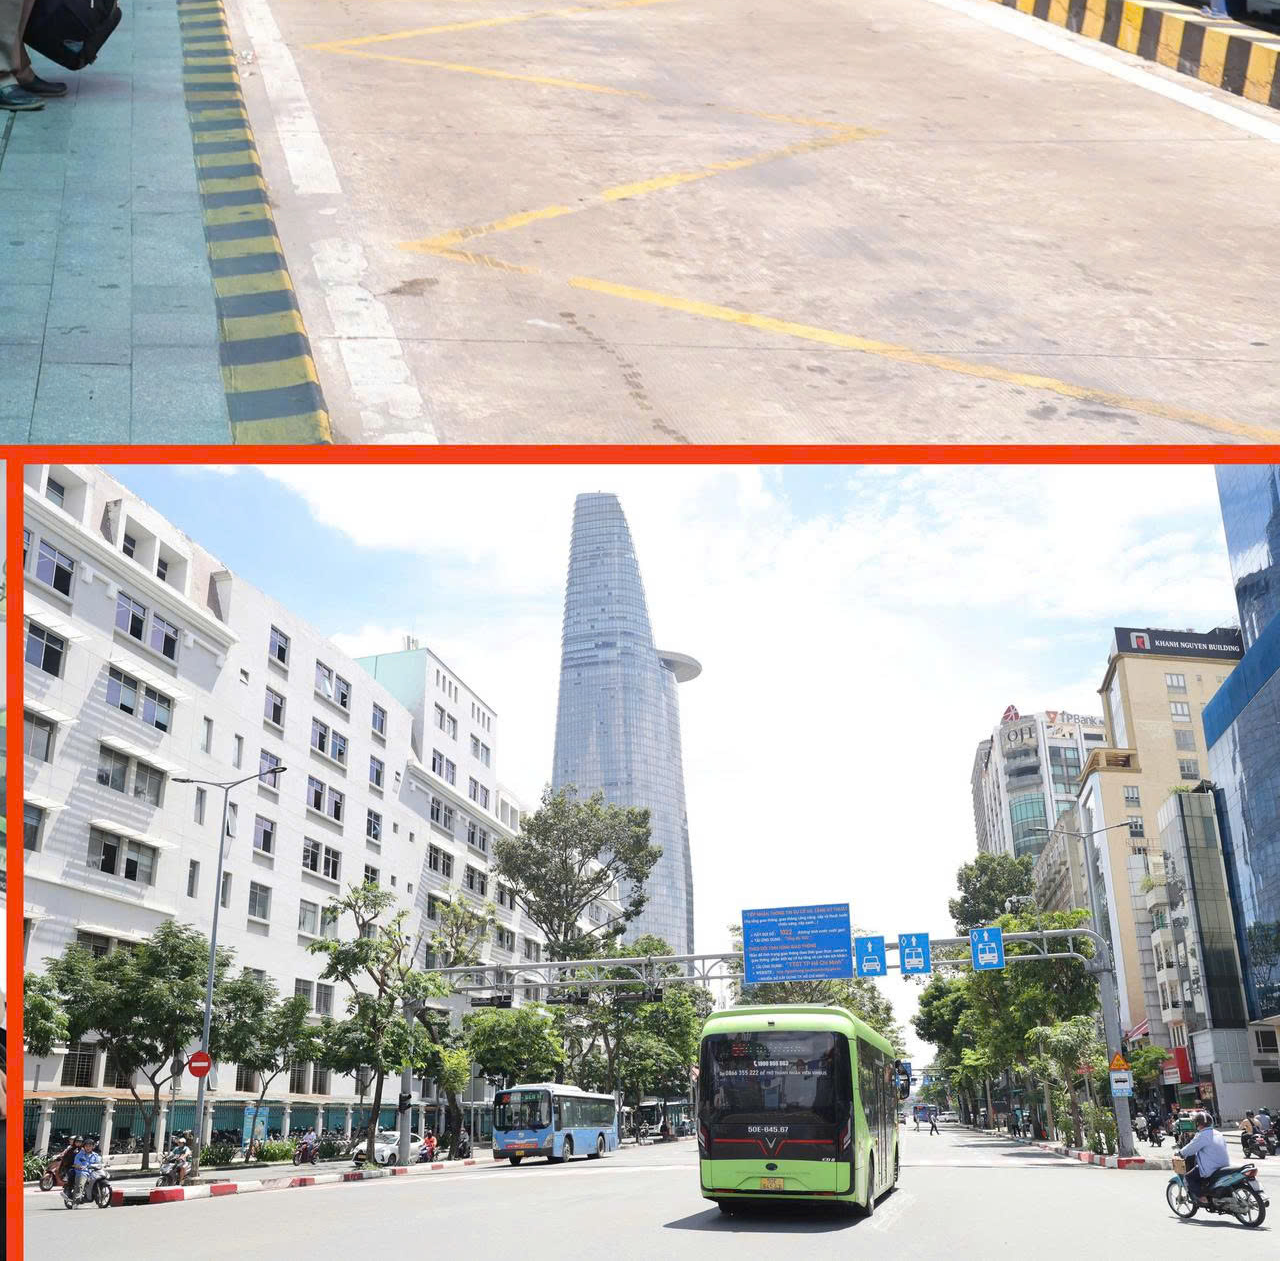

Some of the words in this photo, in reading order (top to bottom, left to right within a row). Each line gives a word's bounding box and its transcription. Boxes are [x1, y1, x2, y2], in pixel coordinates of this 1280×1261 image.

[1155, 639, 1180, 648] KHANH
[1180, 641, 1208, 650] NGUYEN
[1208, 643, 1240, 653] BUILDING
